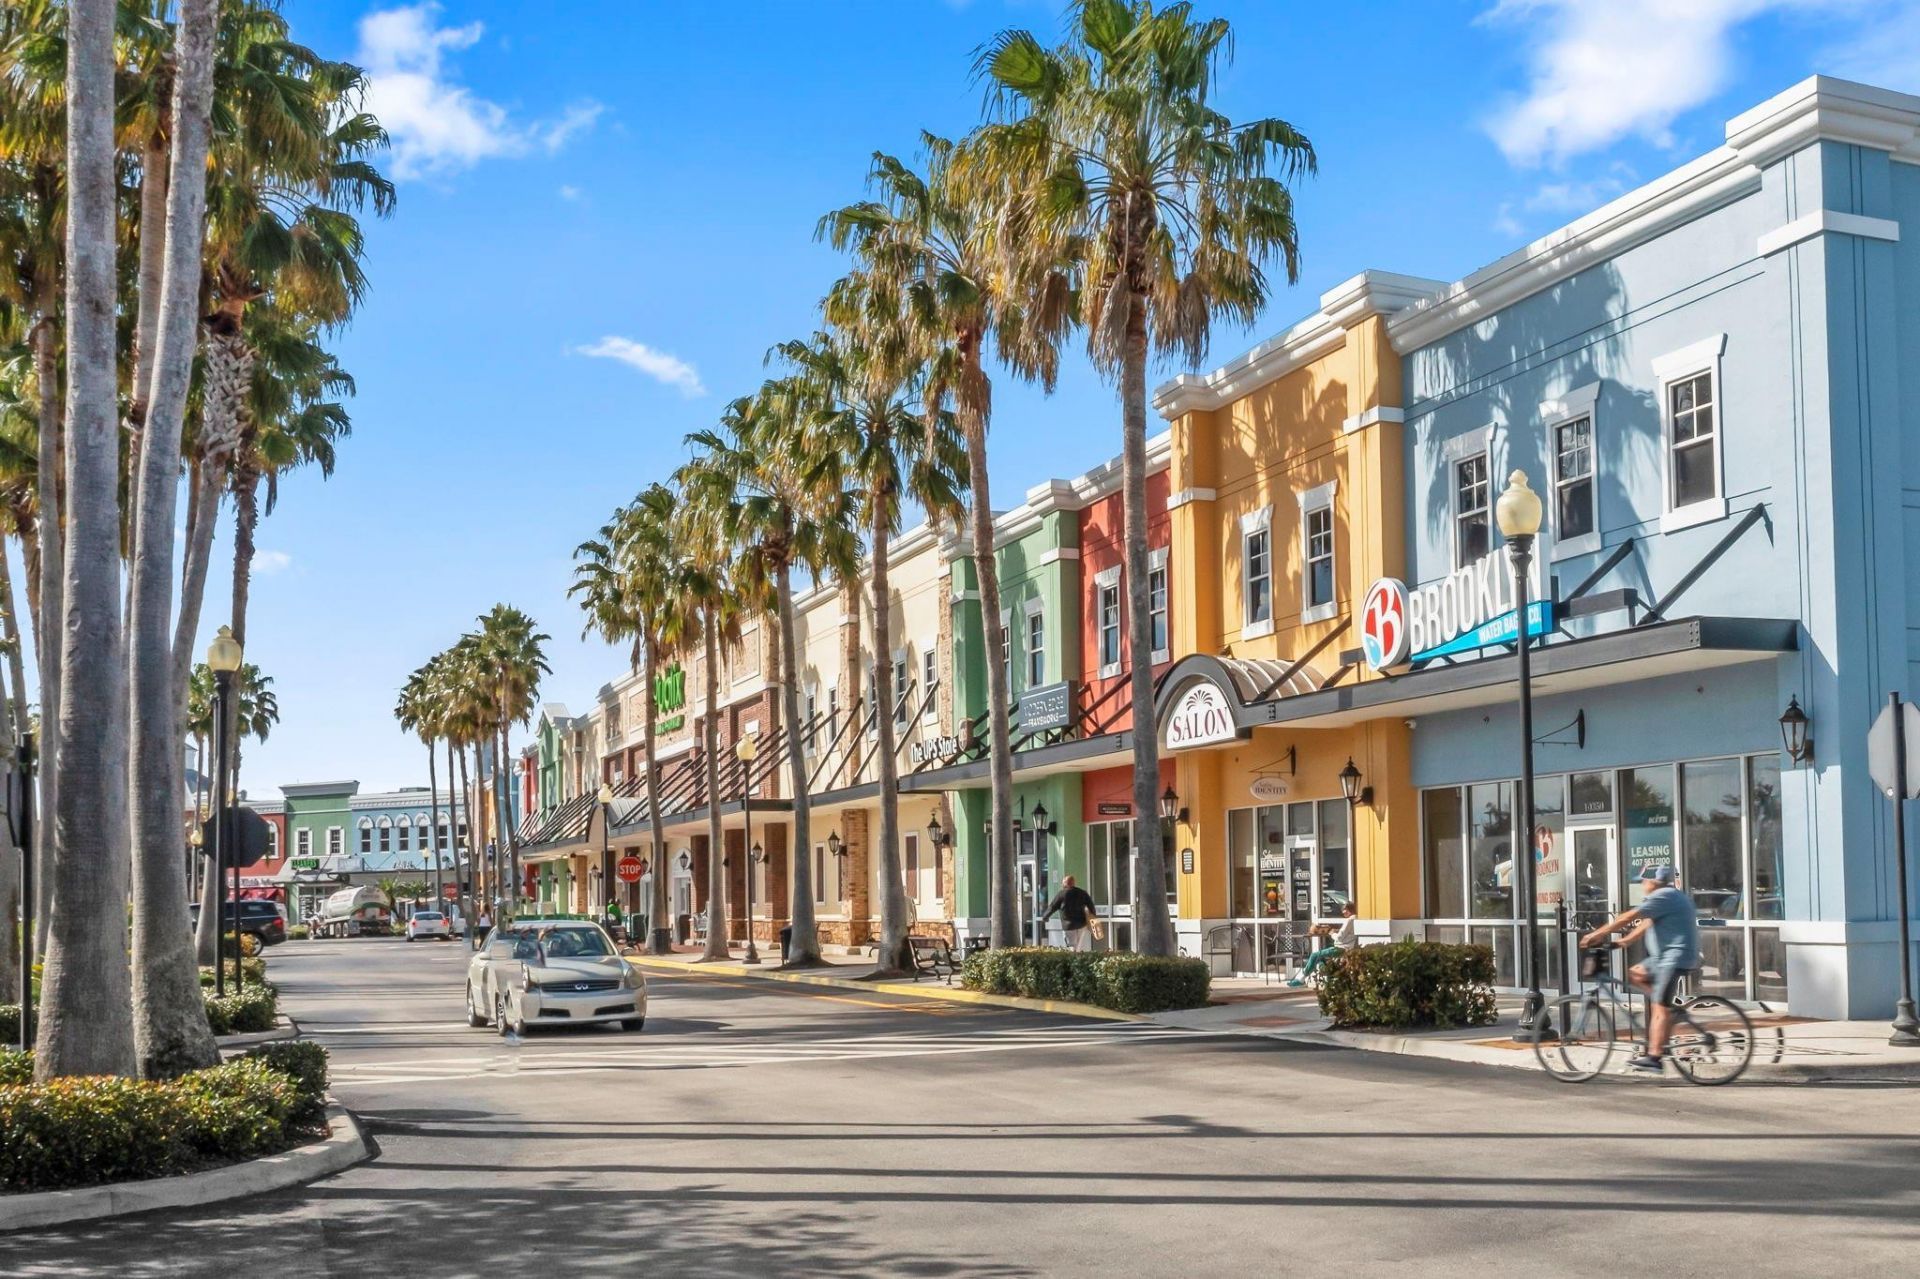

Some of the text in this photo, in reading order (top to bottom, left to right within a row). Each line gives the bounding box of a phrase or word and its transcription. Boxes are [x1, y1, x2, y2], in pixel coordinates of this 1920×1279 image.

[1172, 706, 1228, 743] SALON
[911, 736, 957, 762] The UPS Store
[1631, 845, 1670, 857] LEASING
[619, 864, 641, 875] STOP
